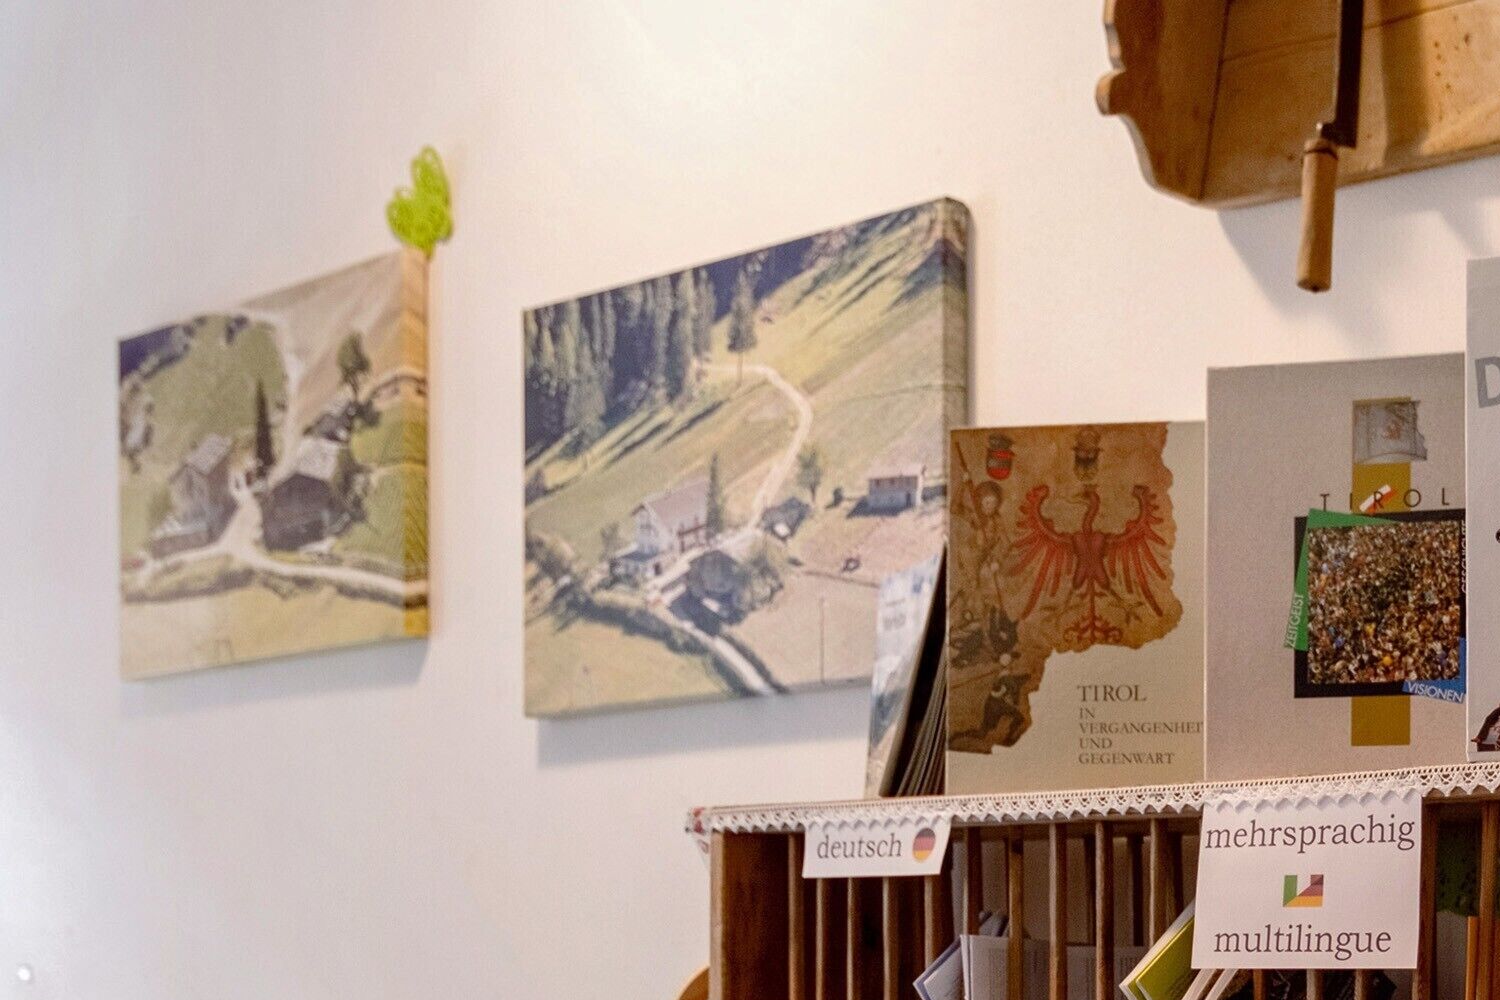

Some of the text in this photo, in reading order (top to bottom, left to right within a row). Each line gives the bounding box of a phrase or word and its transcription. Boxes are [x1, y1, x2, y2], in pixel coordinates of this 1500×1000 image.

[1320, 486, 1450, 512] TIROL
[1077, 684, 1147, 702] TIROL
[1408, 681, 1464, 703] VISIONEN
[1080, 707, 1095, 719] IN
[1079, 722, 1203, 734] VERGANGENHEI
[1080, 737, 1113, 749] UND
[1078, 751, 1175, 764] GEGENWART
[1205, 813, 1415, 854] mehrsprachig
[817, 832, 902, 859] deutsch
[1213, 924, 1392, 961] multilingue
